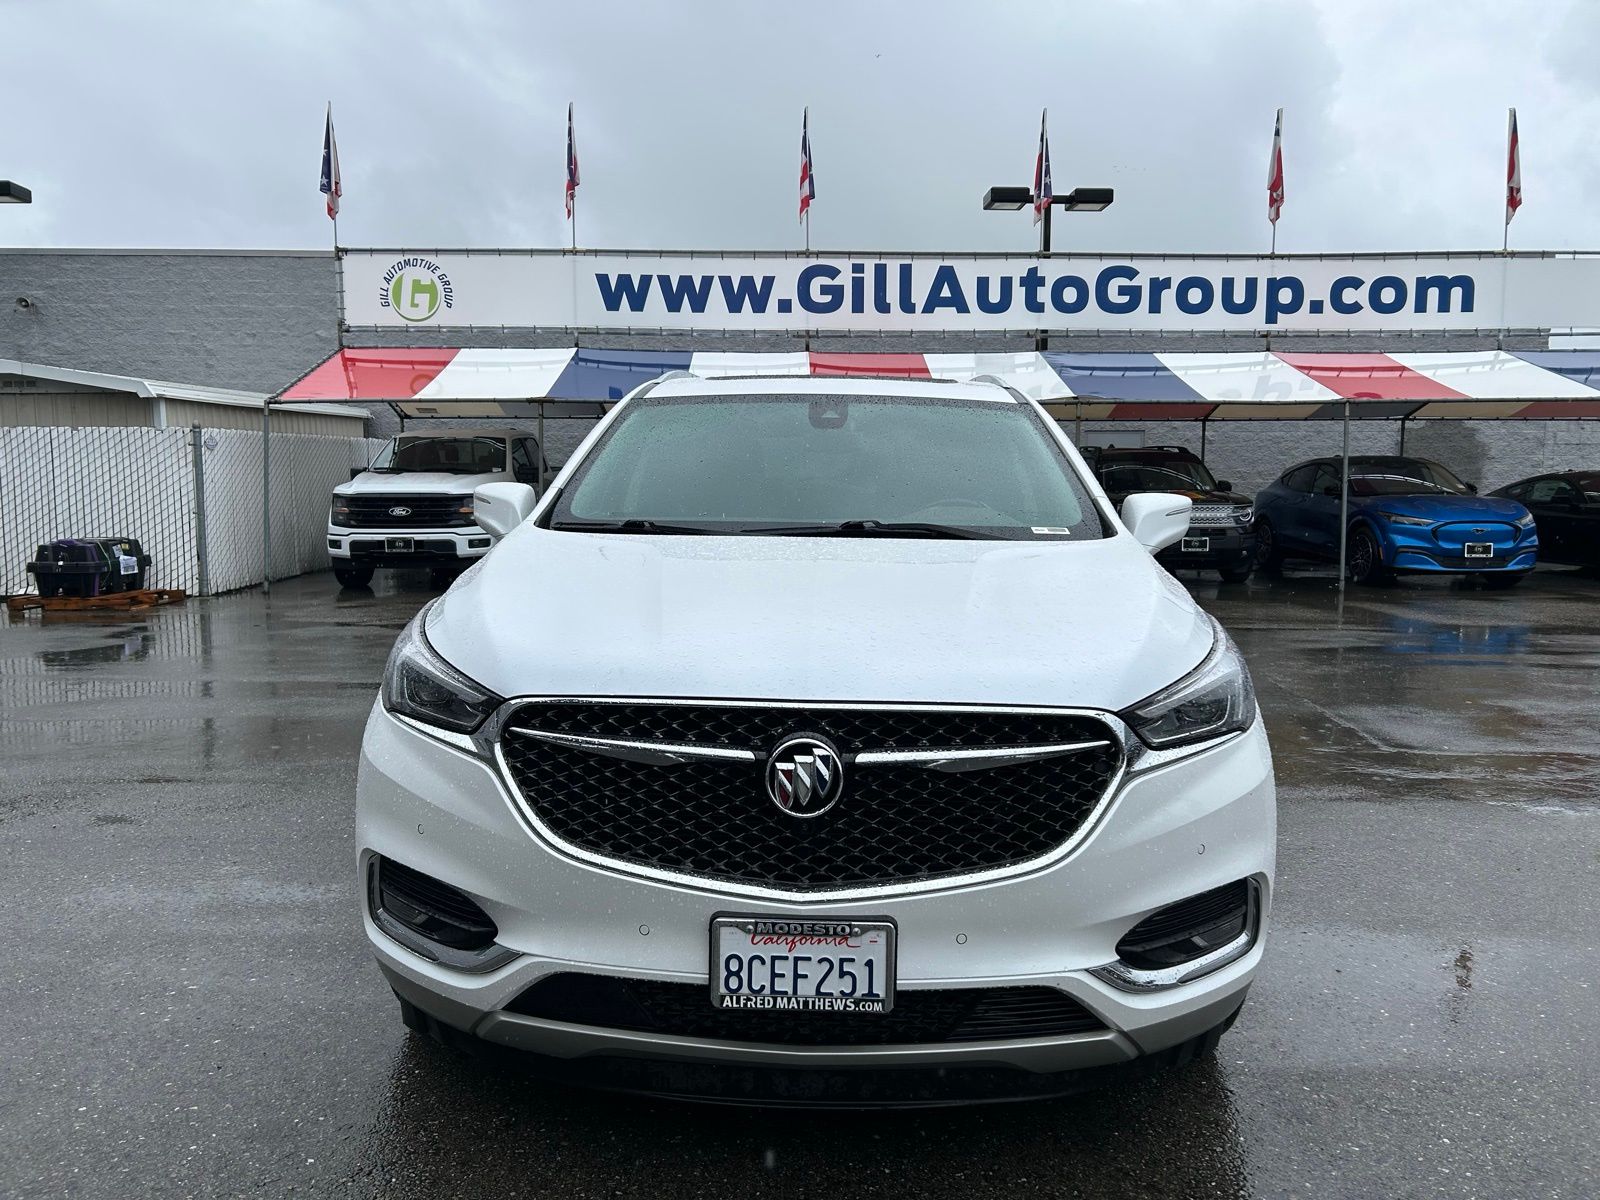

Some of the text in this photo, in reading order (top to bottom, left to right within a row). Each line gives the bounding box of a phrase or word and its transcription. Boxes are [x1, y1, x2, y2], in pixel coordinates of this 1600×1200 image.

[380, 258, 453, 309] GILL AUTOMOTIVE GROUP
[595, 263, 1475, 324] www.GillAutoGroup.com
[751, 933, 861, 953] California
[756, 922, 850, 936] MODESTO
[724, 953, 880, 998] 8CEF251
